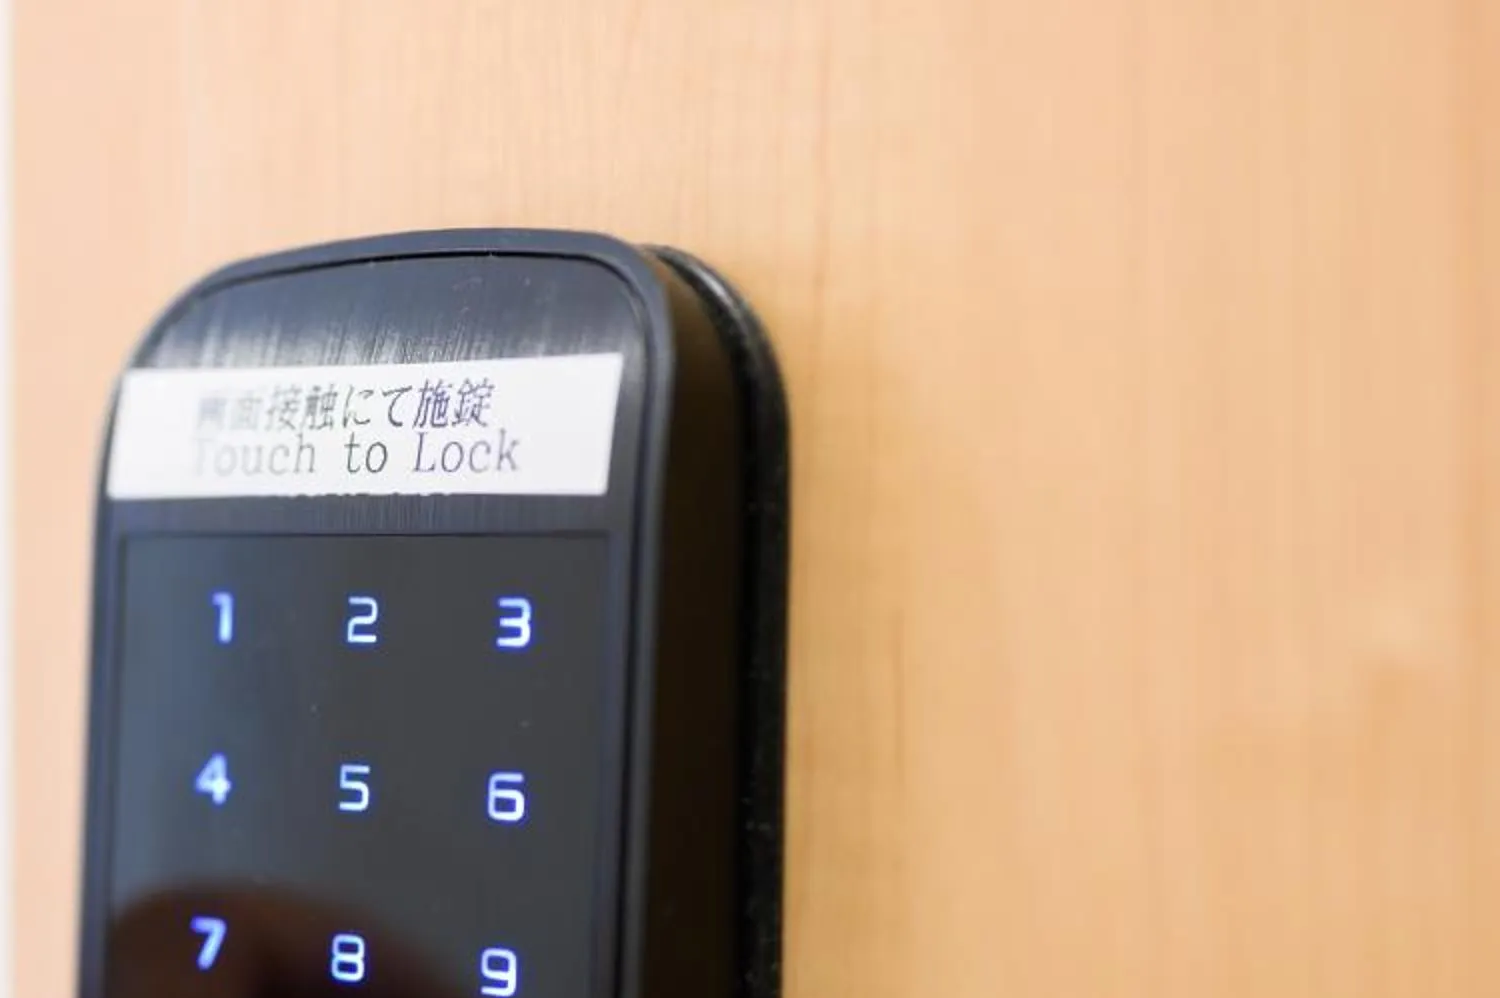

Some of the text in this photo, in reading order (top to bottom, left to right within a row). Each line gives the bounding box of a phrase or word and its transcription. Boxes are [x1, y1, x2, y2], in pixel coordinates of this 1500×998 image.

[192, 427, 521, 477] Touch to Lock
[212, 592, 532, 648] 1 2 3
[195, 753, 525, 822] 4 5 6
[192, 917, 517, 998] 7 8 9
